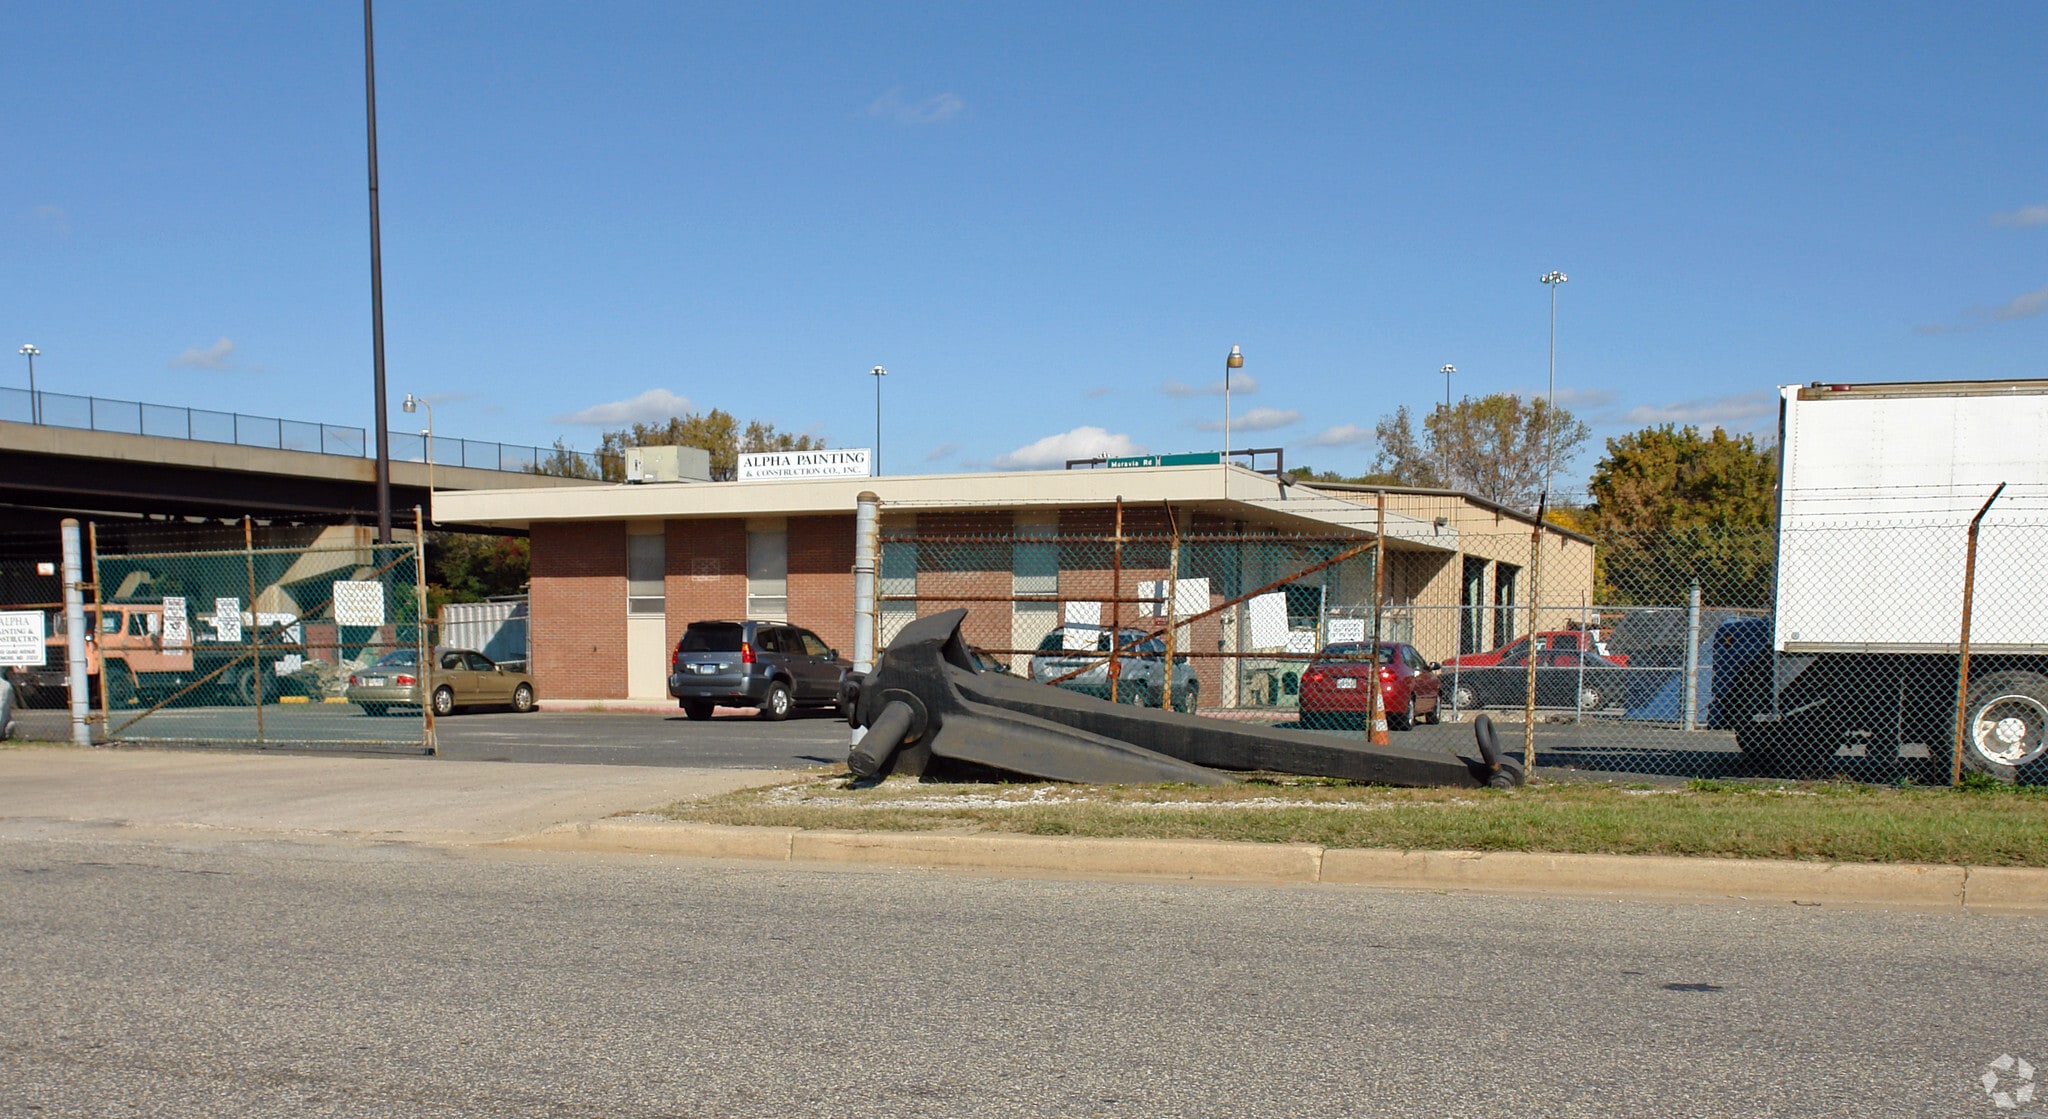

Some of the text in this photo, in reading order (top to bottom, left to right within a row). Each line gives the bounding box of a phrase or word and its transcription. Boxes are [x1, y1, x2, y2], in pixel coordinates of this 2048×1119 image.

[744, 452, 865, 468] ALPHA PAINTING
[756, 467, 820, 477] CONSTRUCTION
[843, 465, 861, 474] INC.
